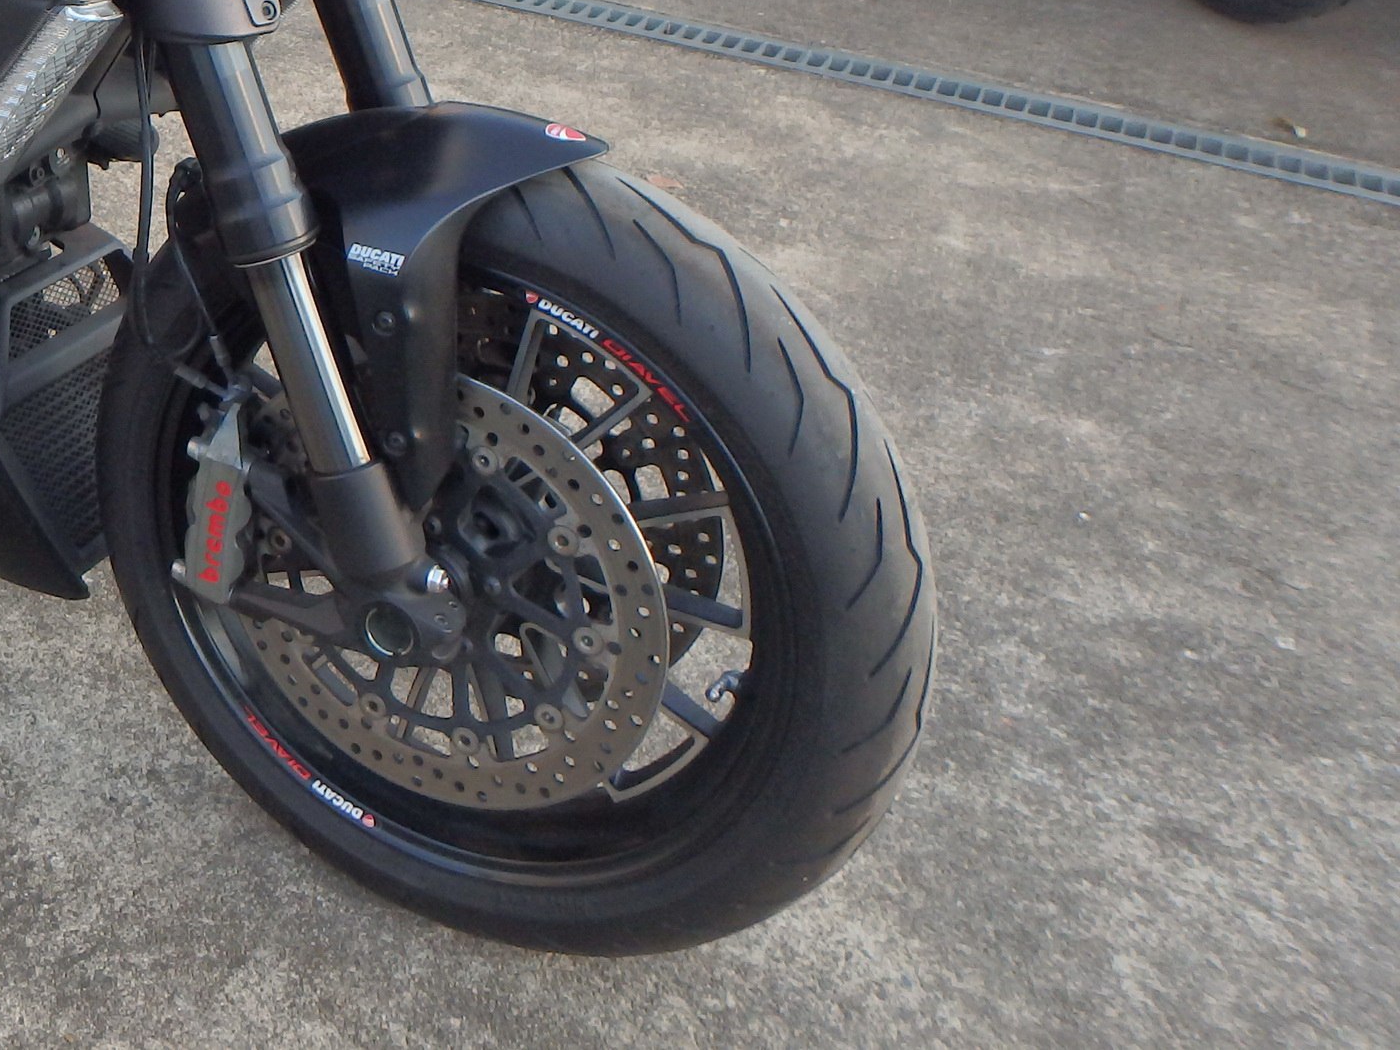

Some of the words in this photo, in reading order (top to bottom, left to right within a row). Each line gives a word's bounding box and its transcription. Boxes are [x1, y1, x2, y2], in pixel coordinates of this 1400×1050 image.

[349, 243, 406, 268] DUCATI
[538, 298, 600, 340] DUCATI
[196, 480, 232, 583] brembo
[311, 779, 364, 820] DUCATI
